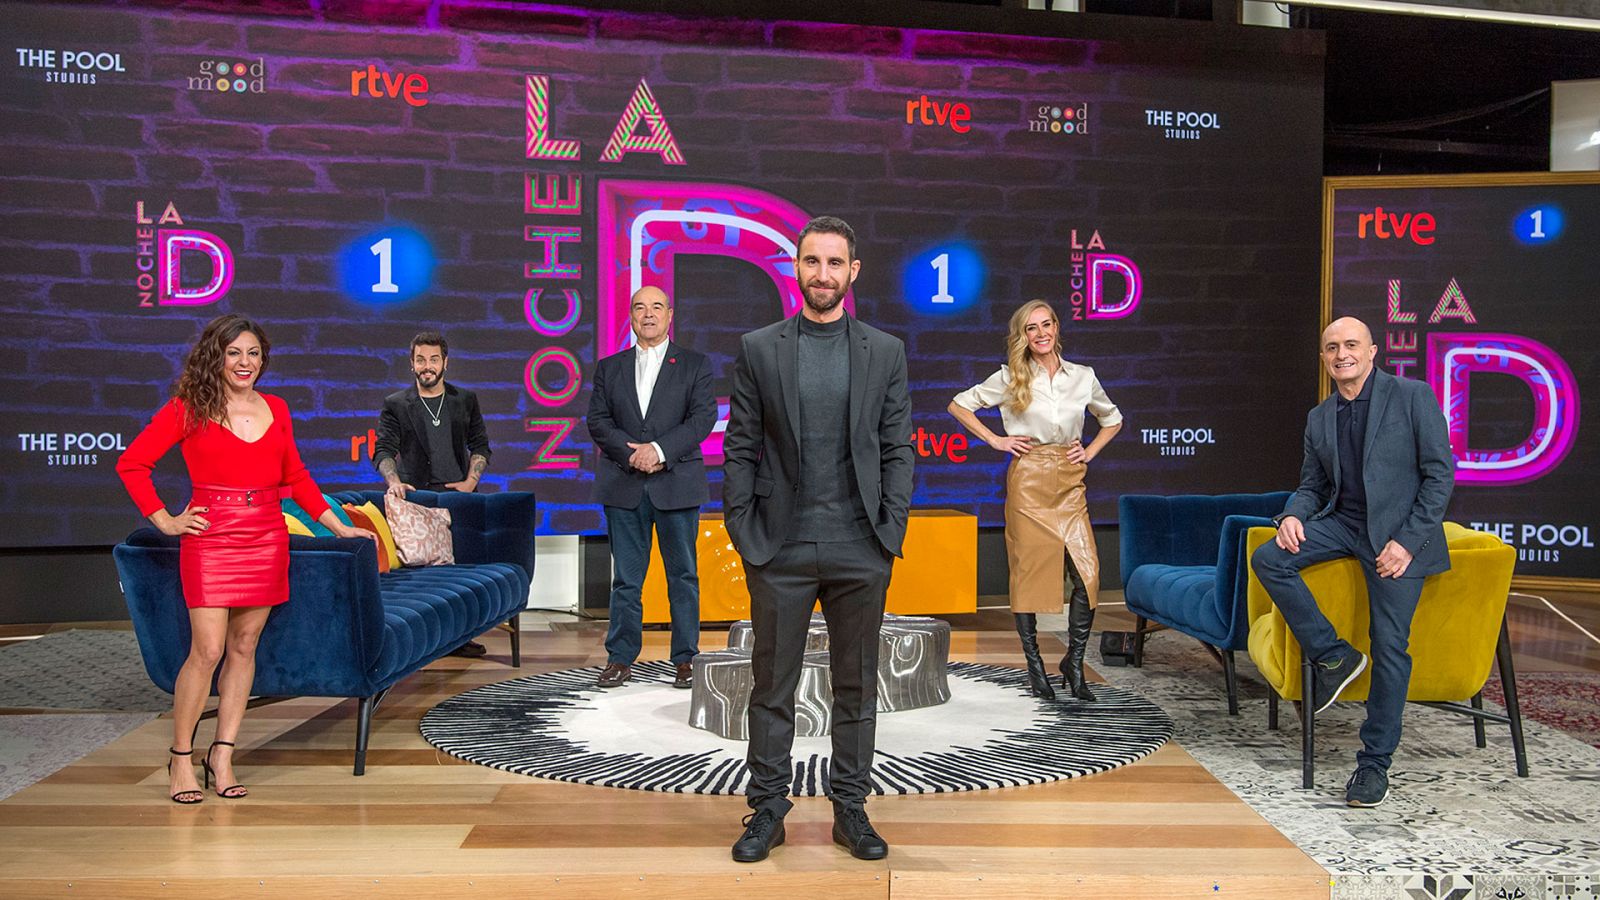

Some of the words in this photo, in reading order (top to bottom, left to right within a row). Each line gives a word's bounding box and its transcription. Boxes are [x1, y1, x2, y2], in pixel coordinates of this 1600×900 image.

[16, 48, 56, 68] THE
[62, 50, 126, 72] POOL
[46, 71, 97, 85] STUDIOS
[351, 64, 429, 106] rtve
[525, 74, 688, 165] LA
[906, 95, 971, 133] rtve
[1144, 109, 1173, 126] THE
[1176, 111, 1221, 129] POOL
[1165, 128, 1201, 140] STUDIOS
[136, 200, 184, 225] LA
[1358, 206, 1436, 245] rtve
[1529, 210, 1545, 238] 1
[1070, 229, 1106, 250] LA
[136, 227, 154, 308] NOCHE
[158, 229, 235, 307] D
[369, 238, 399, 293] 1
[930, 253, 954, 304] 1
[1070, 251, 1084, 321] NOCHE
[1086, 252, 1143, 320] D
[1387, 277, 1478, 324] LA
[524, 172, 582, 470] NOCHE
[1426, 331, 1581, 487] D
[18, 433, 57, 452] THE
[63, 432, 127, 452] POOL
[351, 428, 379, 462] rt
[911, 426, 969, 463] tve
[1141, 428, 1169, 445] THE
[1172, 428, 1216, 444] POOL
[1160, 446, 1196, 456] STUDIOS
[47, 454, 98, 466] STUDIOS
[1521, 523, 1595, 548] POOL
[1519, 548, 1560, 562] UDIOS
